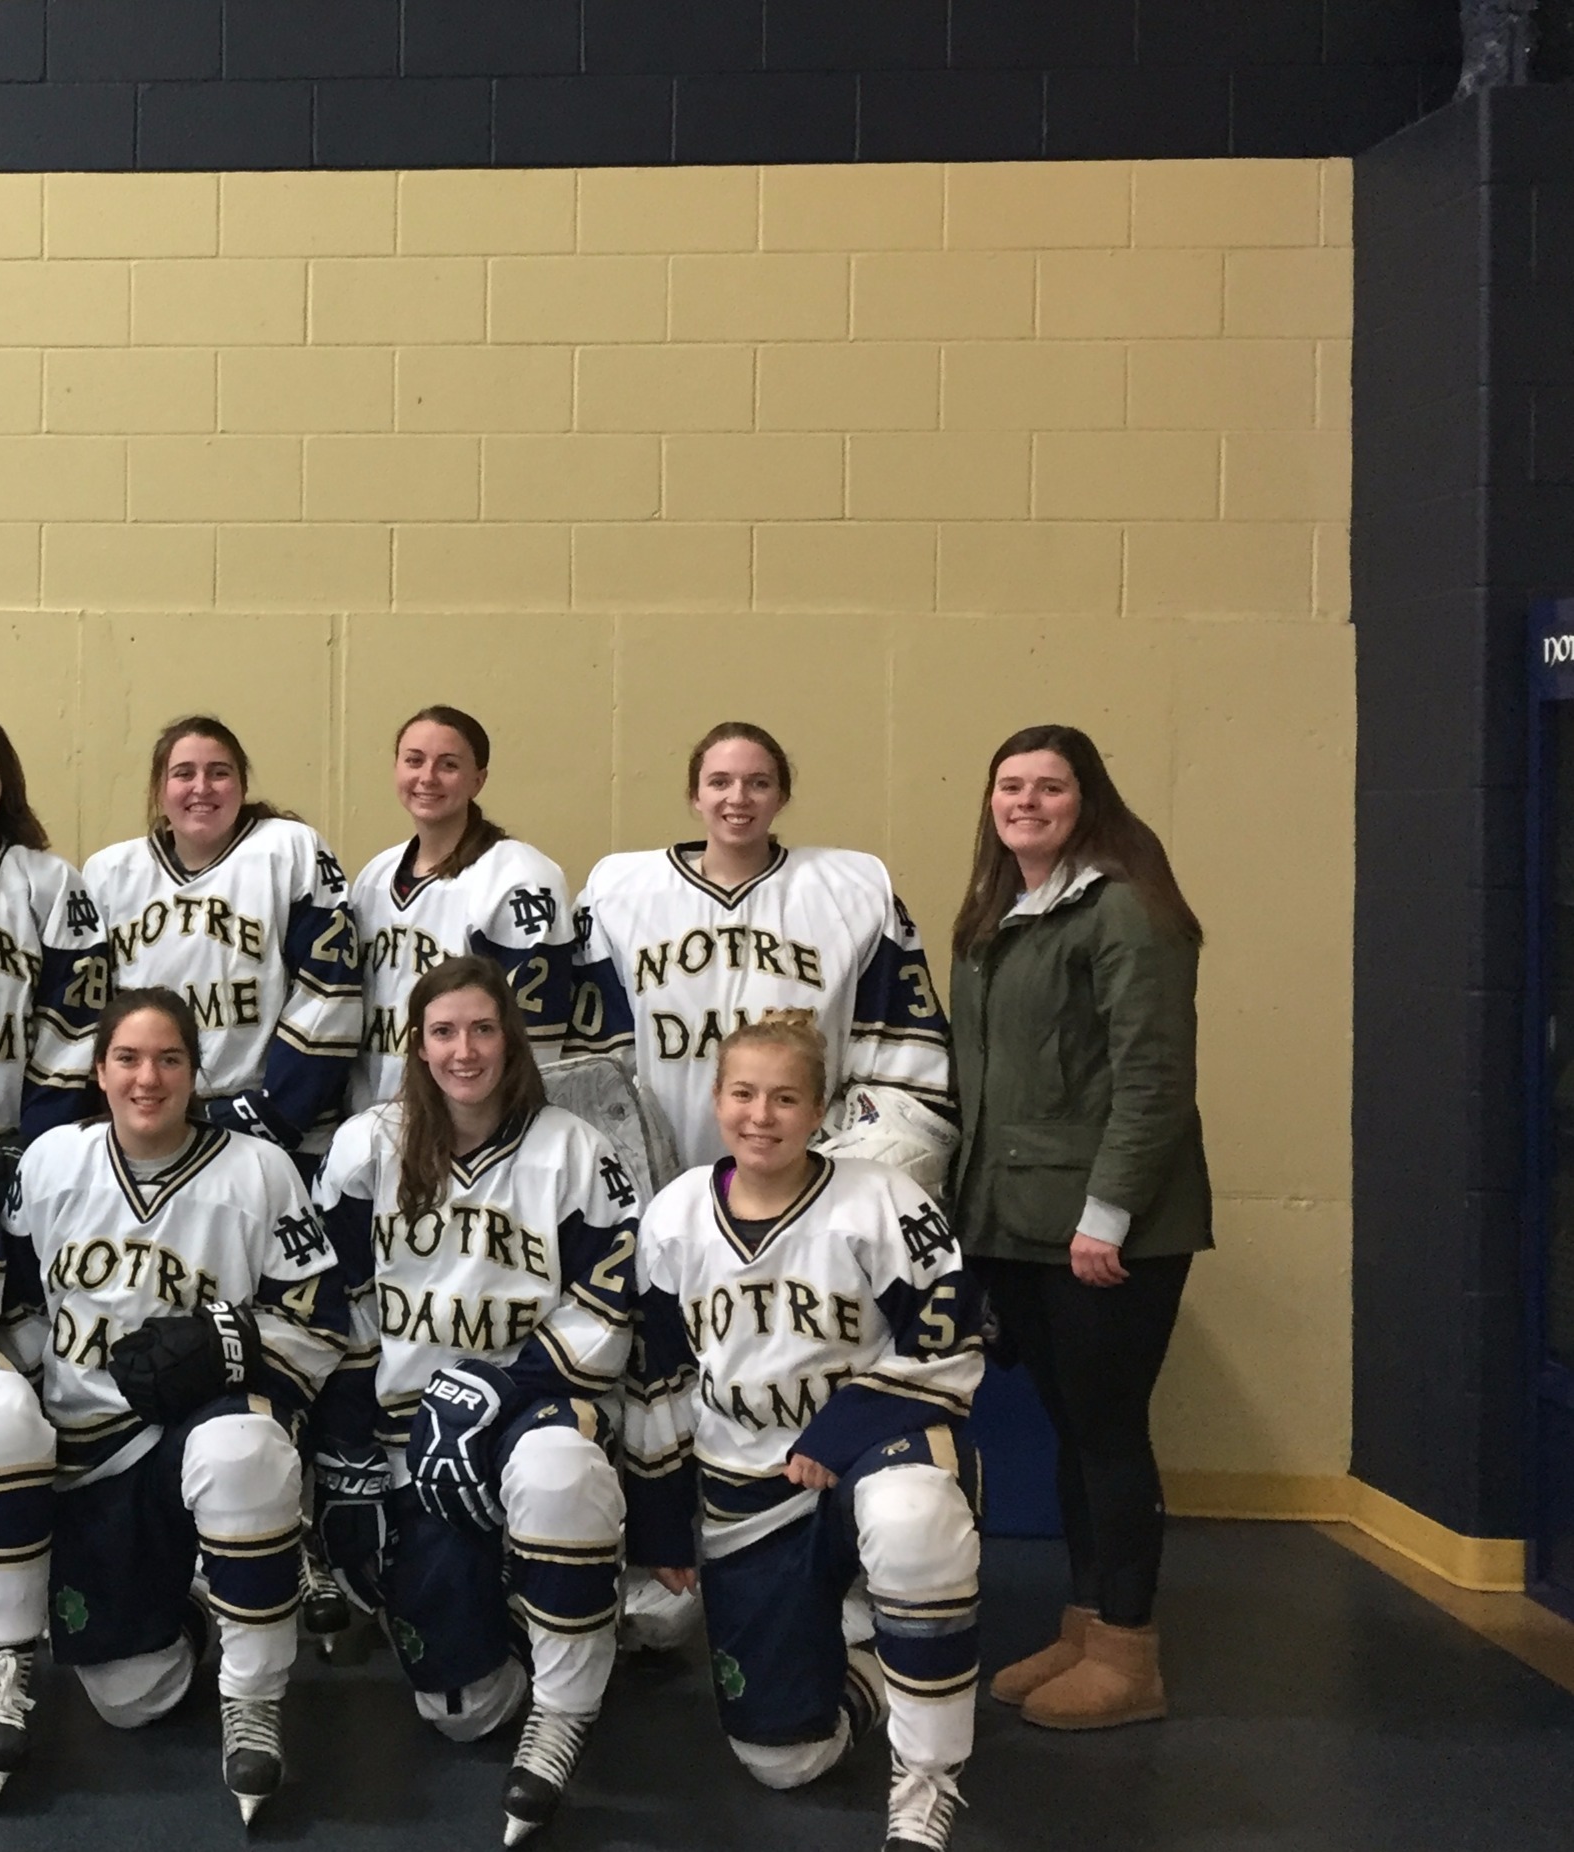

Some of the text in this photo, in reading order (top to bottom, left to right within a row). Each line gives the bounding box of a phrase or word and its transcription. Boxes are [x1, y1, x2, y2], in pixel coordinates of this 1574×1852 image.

[109, 894, 264, 970] NOTRE
[310, 909, 359, 970] 23
[634, 925, 825, 996] NOTRE
[63, 956, 108, 1010] 28
[185, 977, 261, 1030] ME
[506, 956, 549, 1013] 2
[898, 964, 937, 1018] 3
[651, 1008, 816, 1062] DA
[373, 1203, 552, 1282] NOTRE
[589, 1230, 636, 1293] 2
[52, 1304, 112, 1370] DA
[205, 1301, 245, 1383] AUER
[378, 1281, 542, 1351] DAME
[918, 1286, 956, 1350] 5
